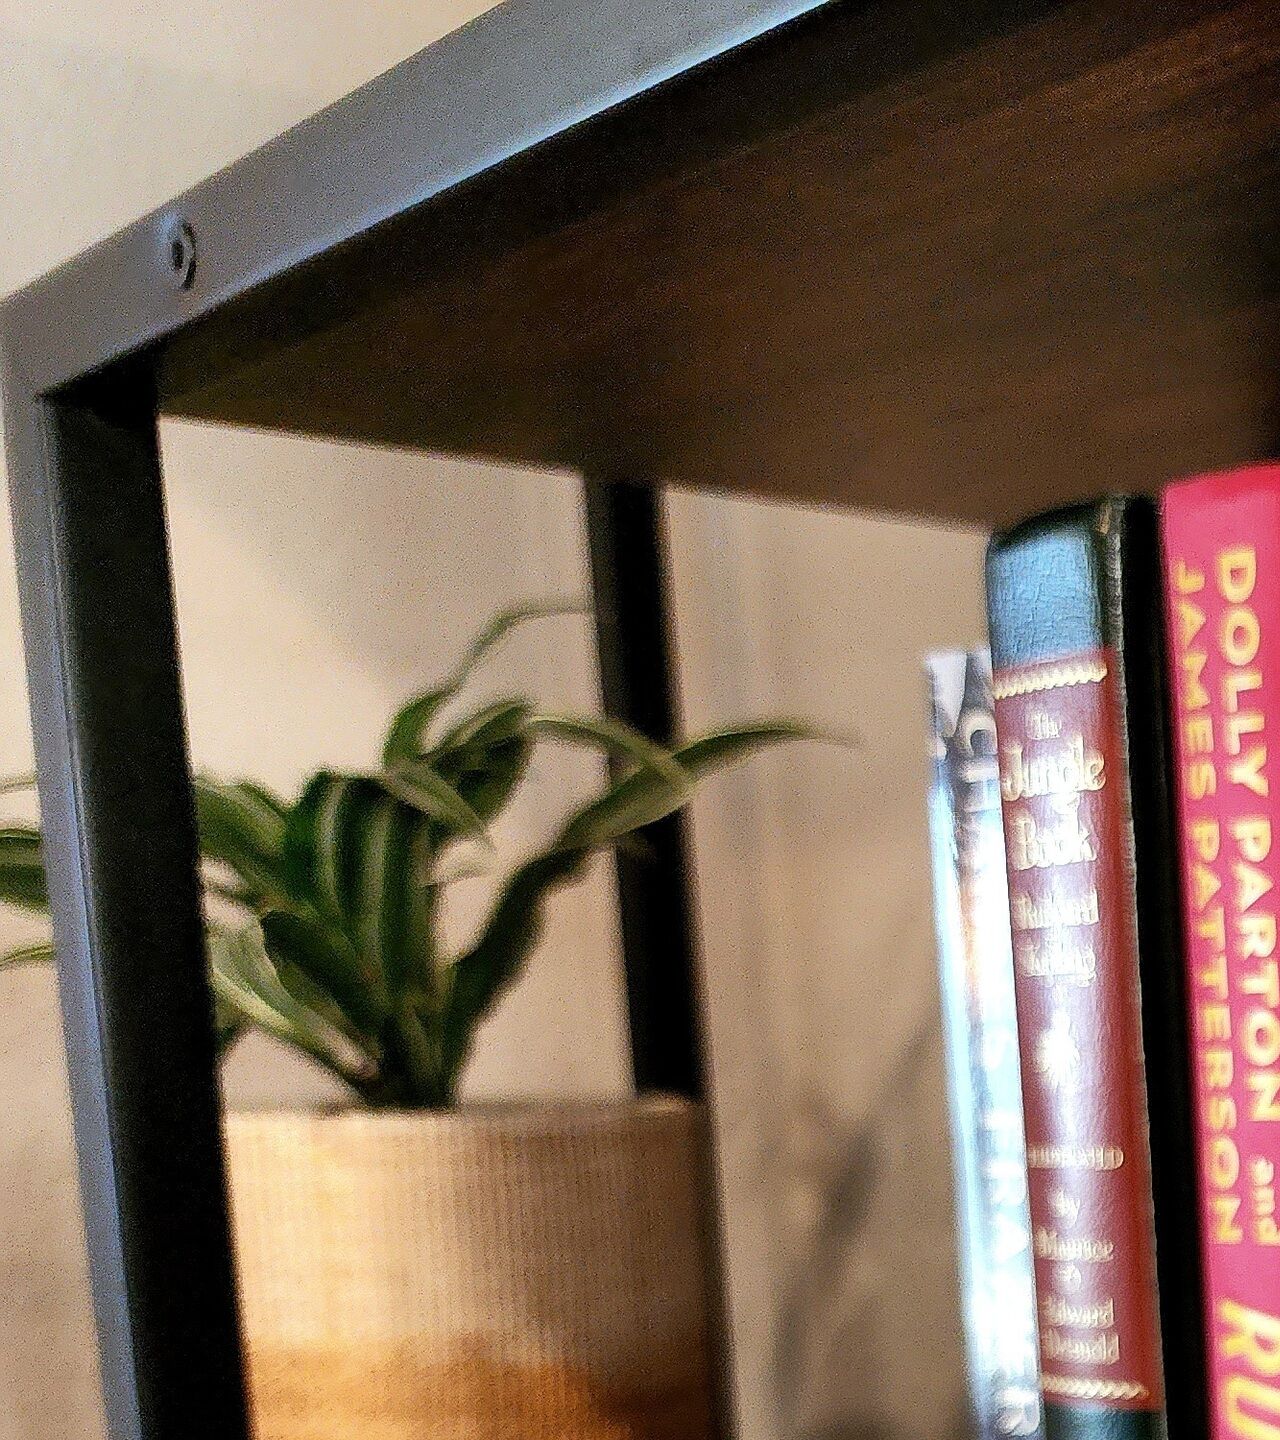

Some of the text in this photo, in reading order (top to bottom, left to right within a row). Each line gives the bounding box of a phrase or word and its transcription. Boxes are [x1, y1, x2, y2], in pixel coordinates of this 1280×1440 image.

[1172, 557, 1244, 1246] JAMES PATTERSON
[1216, 544, 1270, 798] DOLLY
